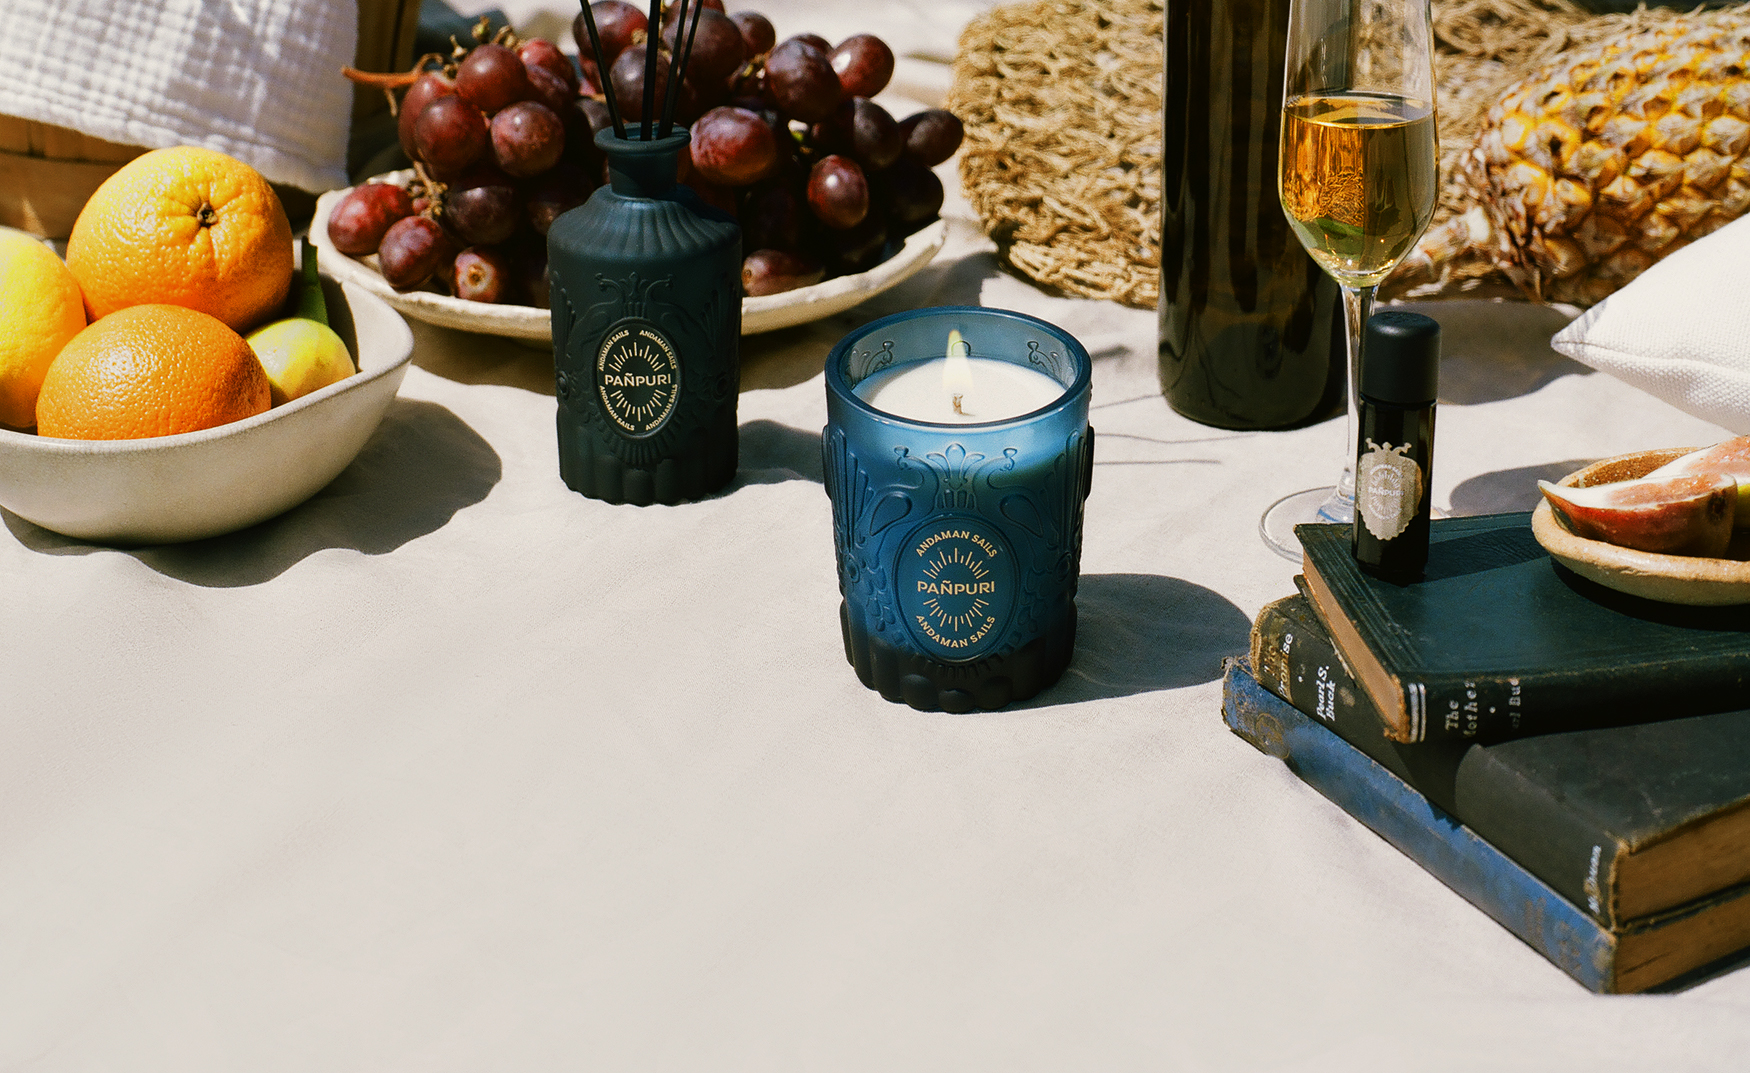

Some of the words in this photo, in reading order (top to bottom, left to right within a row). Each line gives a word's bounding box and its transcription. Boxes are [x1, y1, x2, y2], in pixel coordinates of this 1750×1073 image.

[599, 339, 614, 371] ANDAMAN
[612, 330, 629, 342] SAILS
[639, 330, 669, 352] ANDAMAN
[667, 351, 677, 369] SAILS
[605, 372, 671, 386] PAÑPURI
[600, 385, 618, 419] ANDAMAN
[616, 417, 635, 431] SAILS
[646, 403, 673, 431] ANDAMAN
[670, 384, 678, 403] SAILS
[916, 530, 970, 557] ANDAMAN
[971, 534, 997, 557] SAILS
[917, 580, 995, 595] PAÑPURI
[916, 615, 968, 648] ANDAMAN
[970, 616, 995, 643] SAILS
[1278, 633, 1293, 698] Promise
[1317, 665, 1329, 681] S.
[1316, 679, 1326, 721] Pearl
[1325, 680, 1336, 721] Buck
[1445, 699, 1459, 730] The
